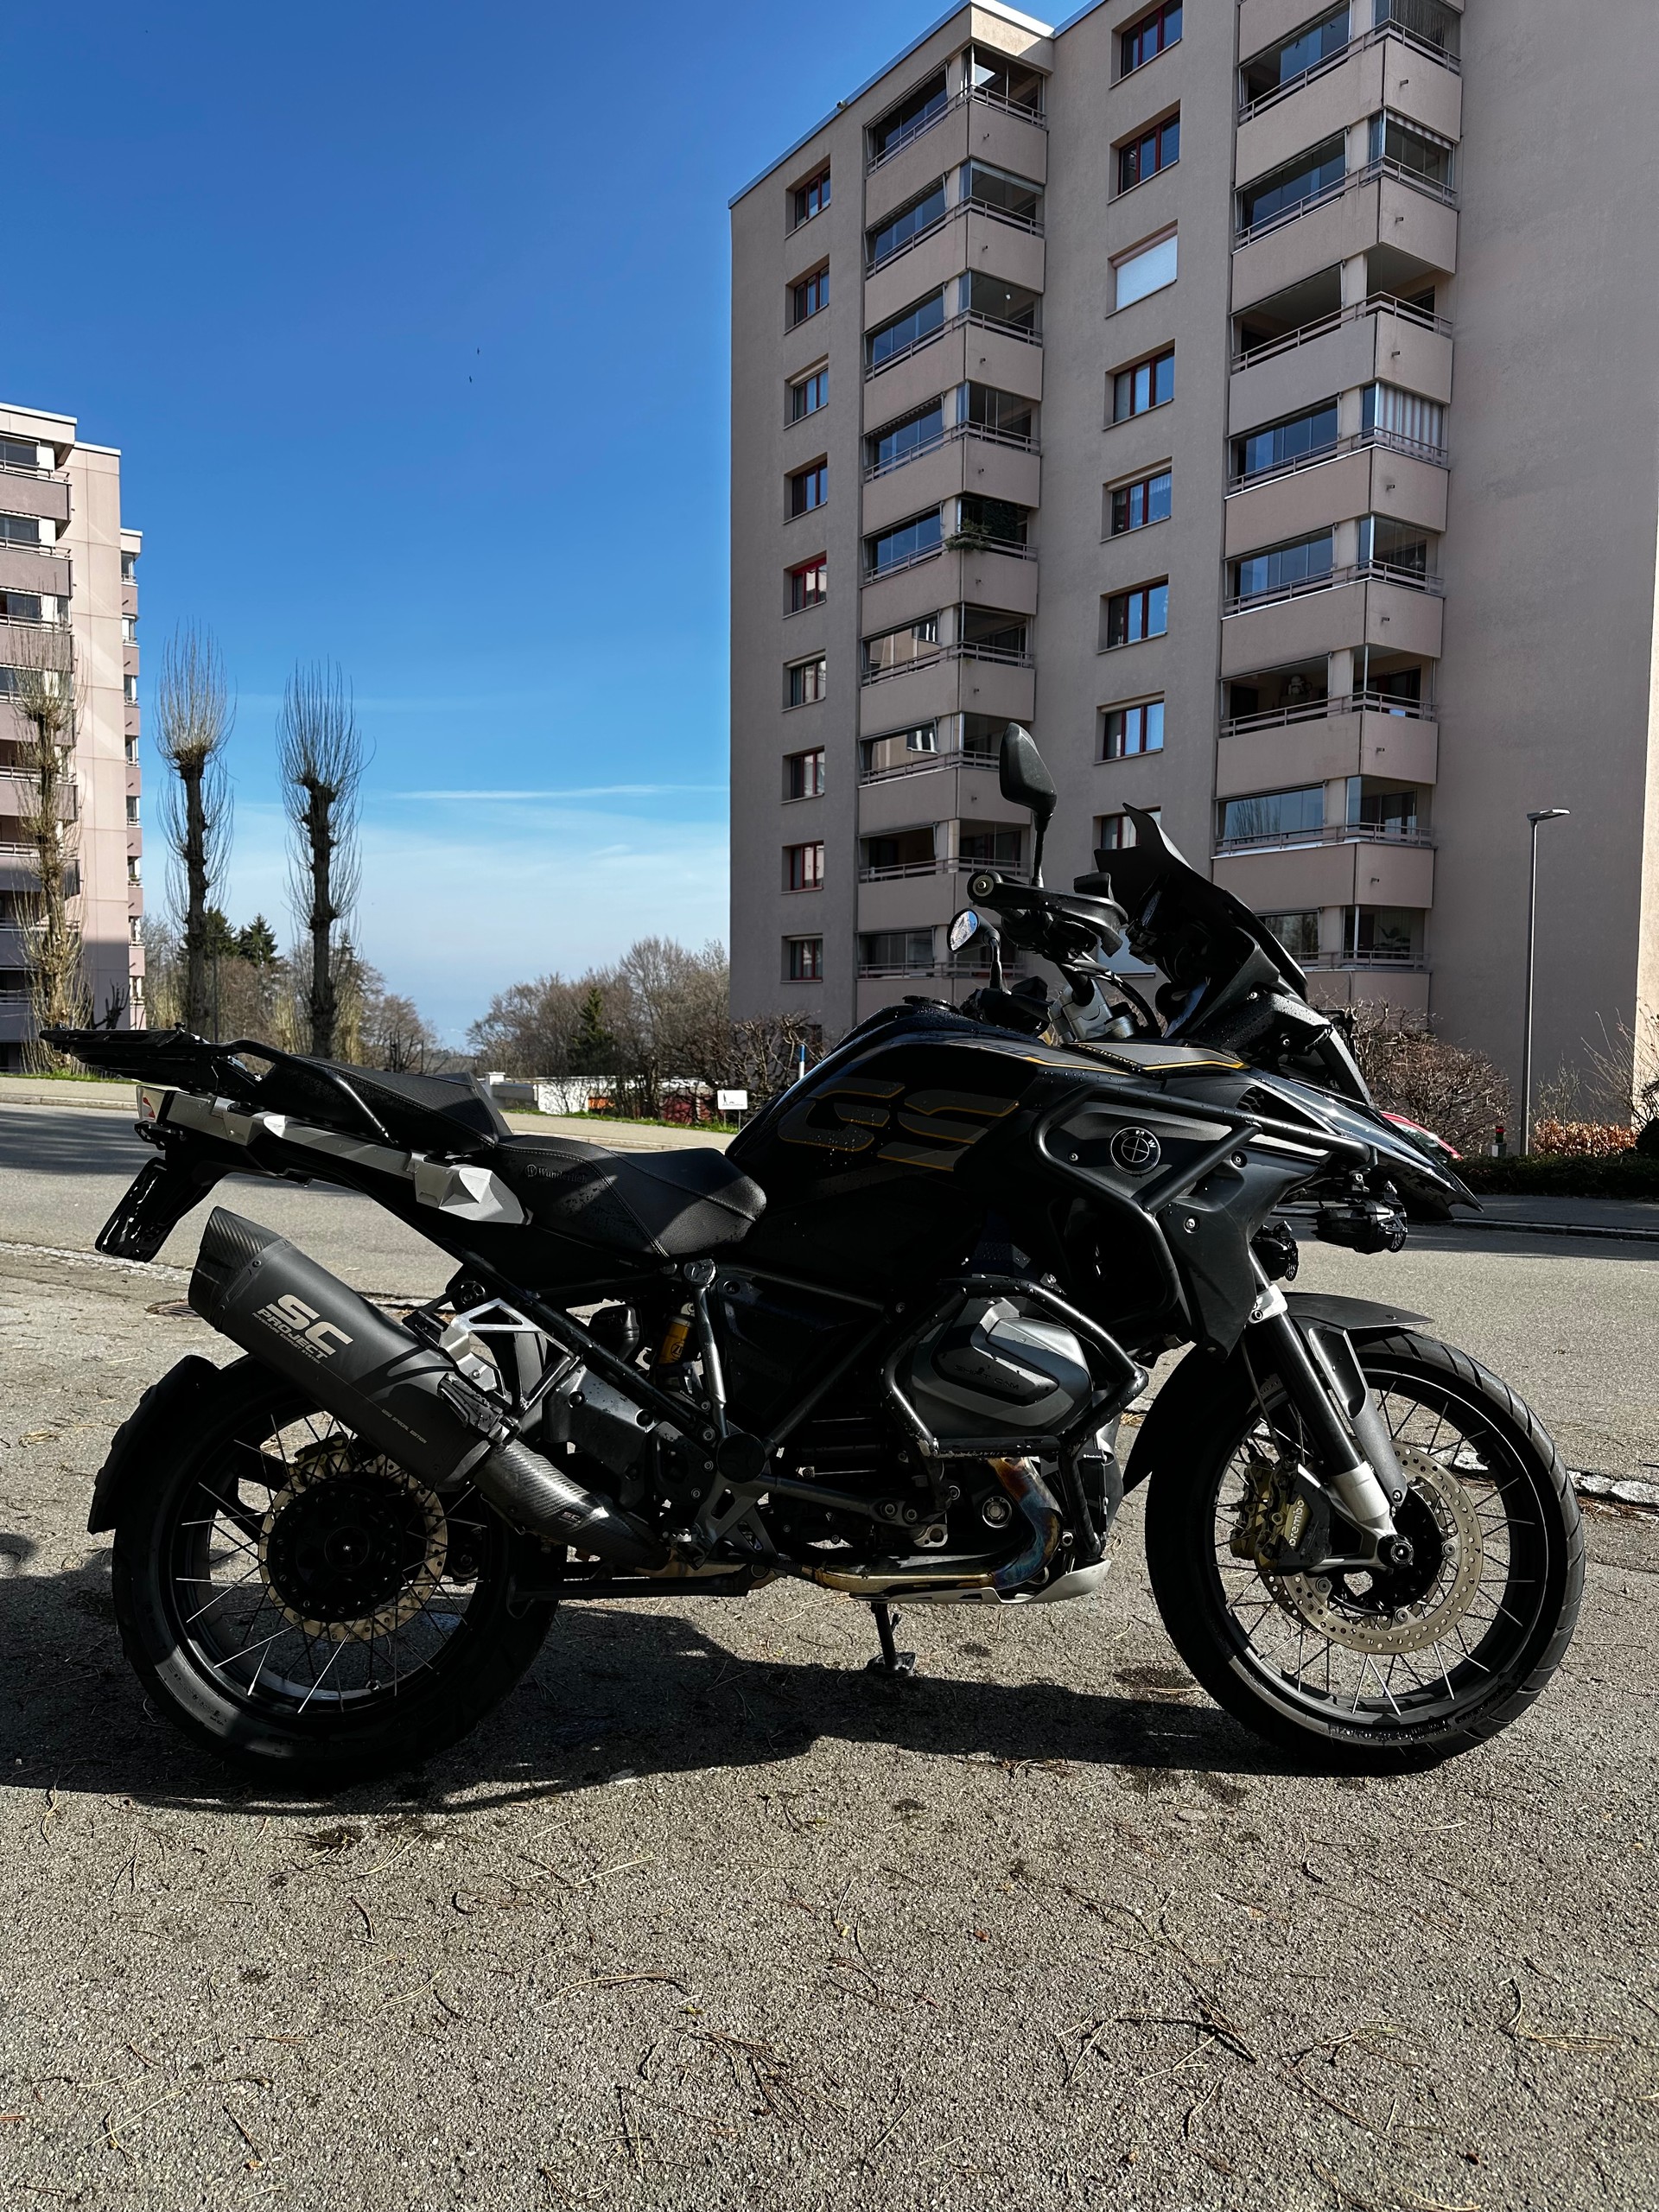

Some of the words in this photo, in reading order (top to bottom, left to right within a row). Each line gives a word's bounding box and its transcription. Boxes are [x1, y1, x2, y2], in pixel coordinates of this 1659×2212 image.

[778, 1077, 1020, 1173] GS
[257, 1308, 328, 1359] PROJECT
[265, 1294, 354, 1356] SC
[1288, 1499, 1305, 1547] brembo
